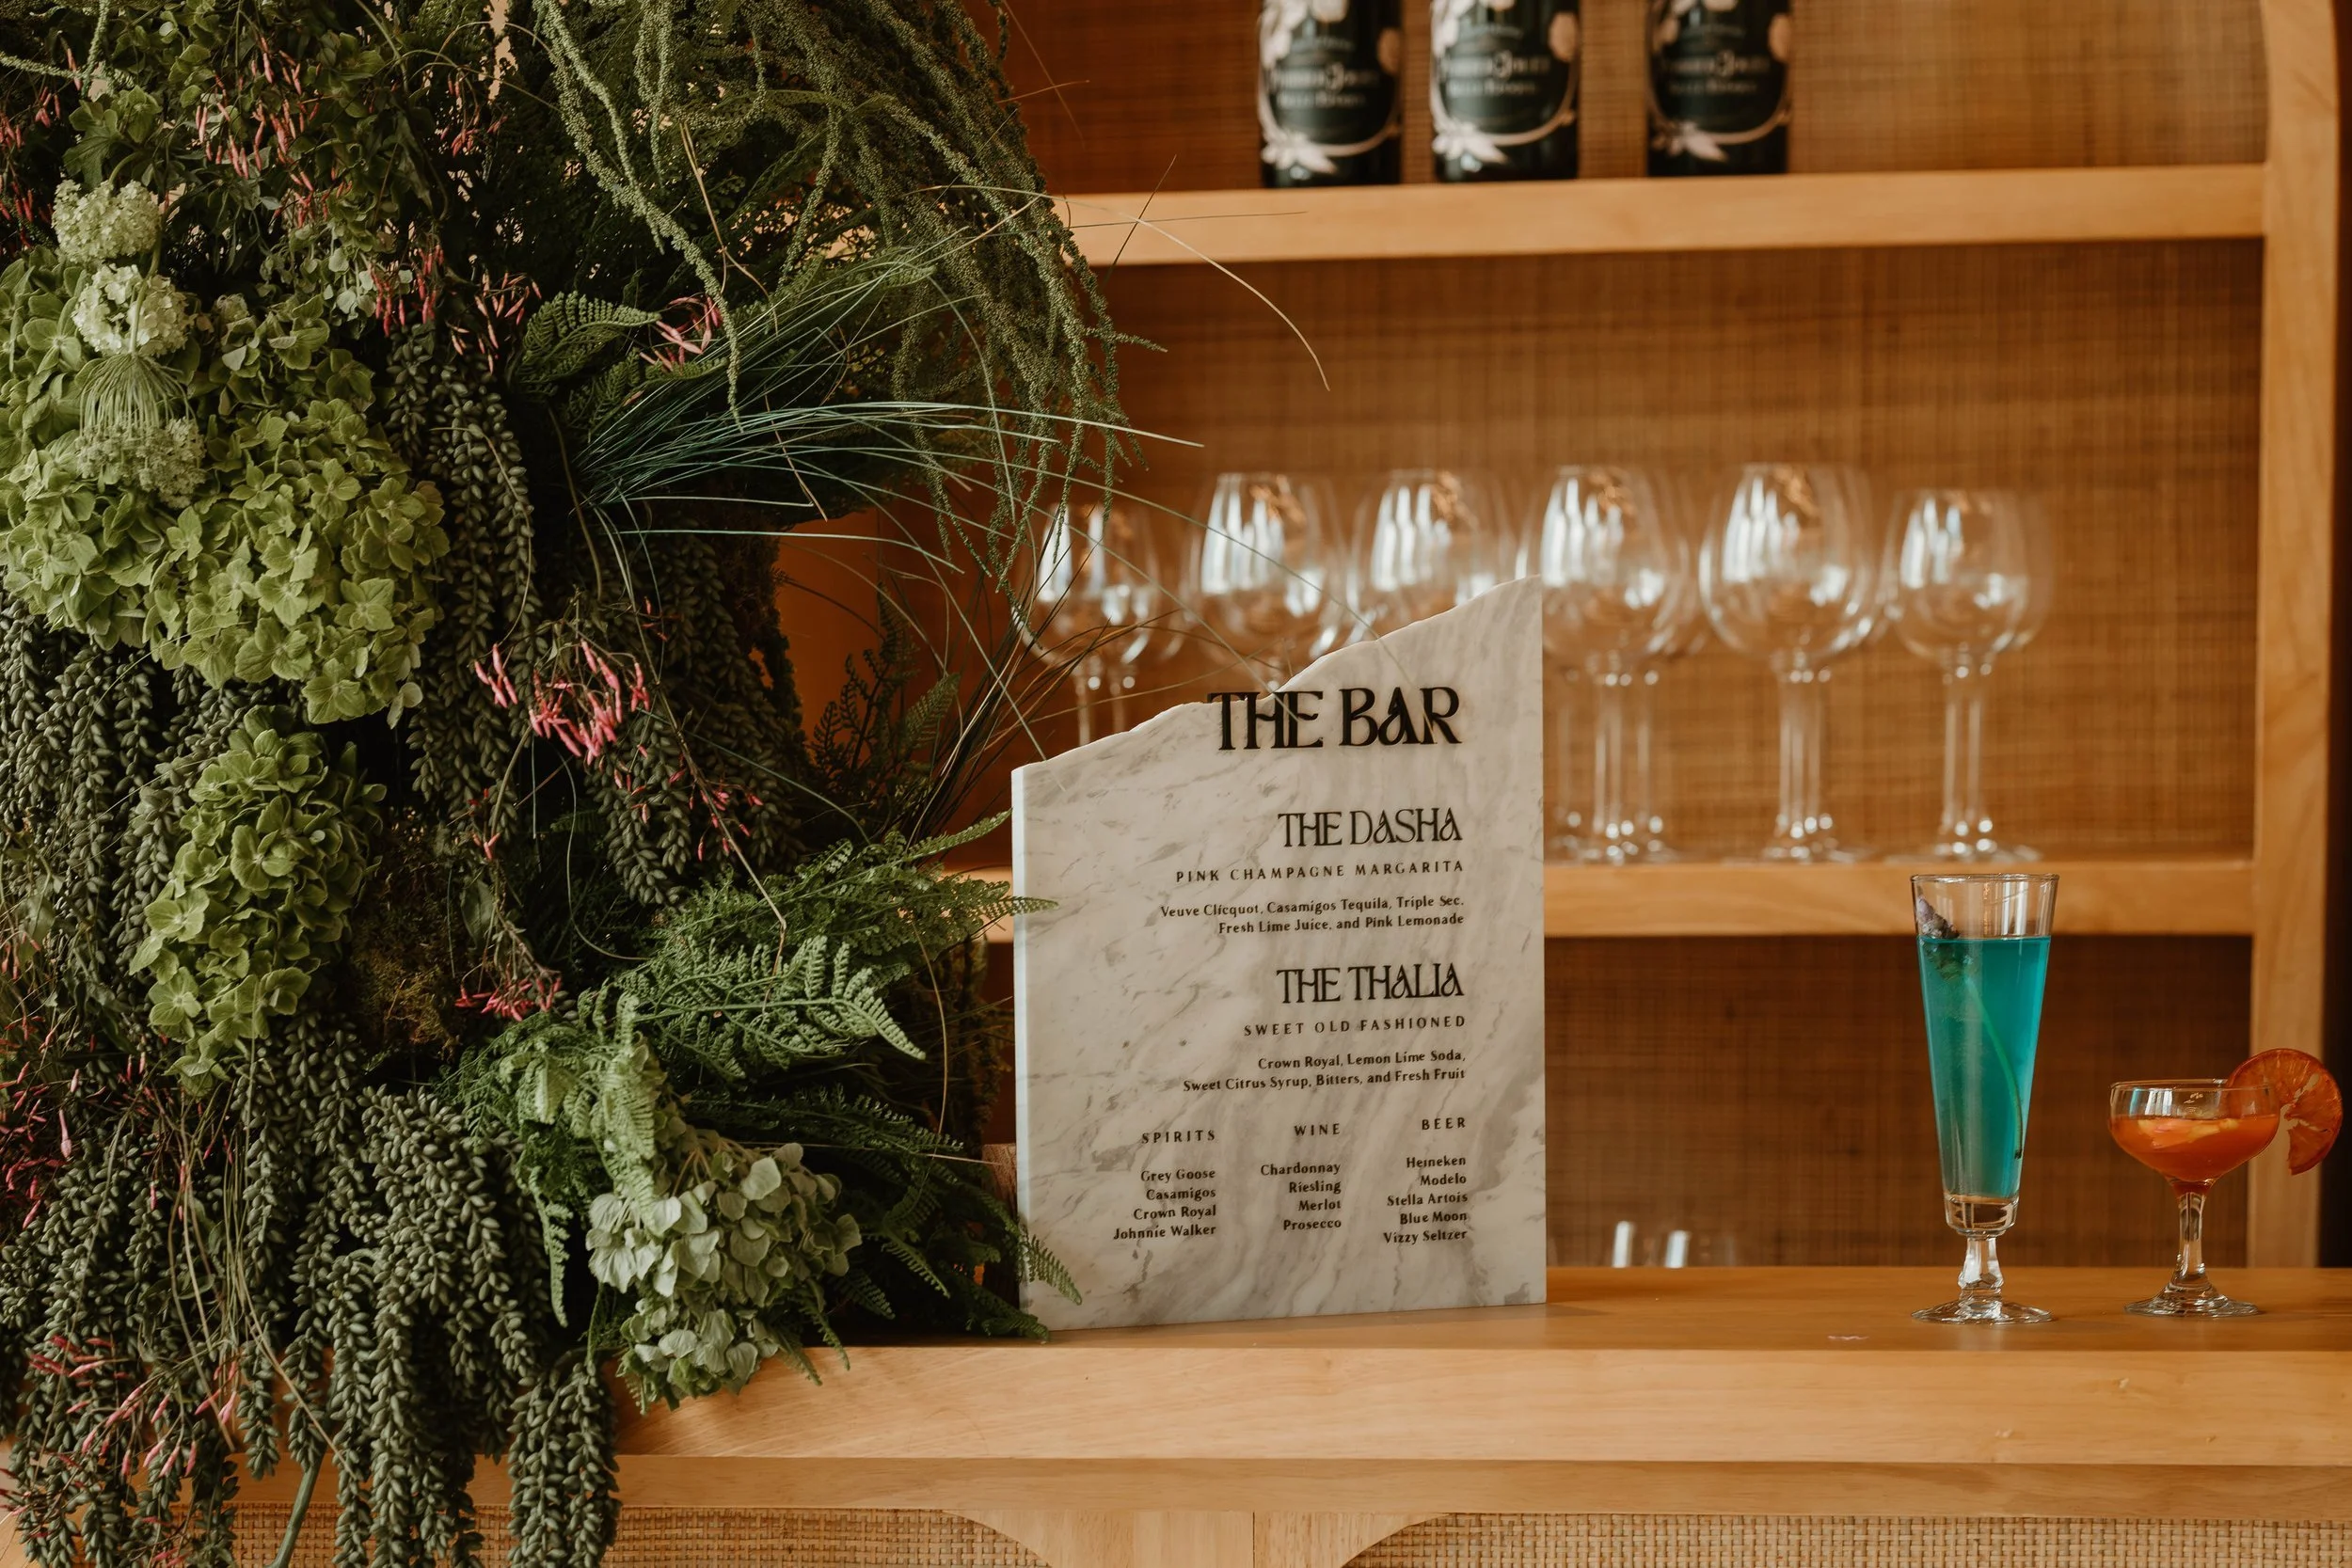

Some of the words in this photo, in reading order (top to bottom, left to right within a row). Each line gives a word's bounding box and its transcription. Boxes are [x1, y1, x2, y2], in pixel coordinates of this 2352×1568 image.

[1208, 690, 1324, 751] THE
[1339, 687, 1462, 746] BAR
[1278, 811, 1342, 847] THE
[1350, 808, 1462, 845] DASHA
[1176, 869, 1219, 882] PINK
[1230, 865, 1344, 880] CHAMPAGNE
[1355, 860, 1463, 876] MARGARITA
[1160, 905, 1200, 917] Veuve
[1266, 900, 1336, 915] Casamigos
[1340, 897, 1392, 912] Tequila,
[1396, 895, 1435, 910] Triple
[1218, 922, 1254, 934] Fresh
[1259, 920, 1290, 932] Lime
[1336, 916, 1360, 929] and
[1365, 914, 1393, 928] Pink
[1398, 912, 1464, 927] Lemonade
[1276, 967, 1341, 1004] THE
[1347, 962, 1465, 1001] THALIA
[1244, 1022, 1304, 1037] SWEET
[1314, 1020, 1350, 1034] OLD
[1360, 1015, 1466, 1031] FASHIONED
[1258, 1057, 1300, 1069] Crown
[1346, 1053, 1391, 1065] Lemon
[1395, 1051, 1425, 1064] Lime
[1430, 1049, 1466, 1062] Soda,
[1183, 1080, 1221, 1091] Sweet
[1225, 1078, 1266, 1089] Citrus
[1316, 1074, 1363, 1086] Bitters,
[1367, 1071, 1391, 1084] and
[1395, 1069, 1430, 1082] Fresh
[1434, 1068, 1465, 1080] Fruit
[1294, 1123, 1340, 1136] WINE
[1422, 1117, 1466, 1130] BEER
[1141, 1130, 1215, 1144] SPIRITS
[1261, 1162, 1341, 1176] Chardonnay
[1406, 1155, 1466, 1168] Heineken
[1140, 1170, 1171, 1183] Grey
[1176, 1168, 1216, 1180] Goose
[1420, 1172, 1467, 1186] Modelo
[1146, 1187, 1216, 1202] Casamigos
[1289, 1180, 1342, 1195] Riesling
[1298, 1198, 1341, 1212] Merlot
[1387, 1194, 1423, 1207] Stella
[1428, 1192, 1468, 1205] Artois
[1133, 1208, 1176, 1220] Crown
[1181, 1204, 1216, 1220] Royal
[1399, 1212, 1429, 1225] Blue
[1432, 1211, 1468, 1223] Moon
[1113, 1224, 1166, 1240] Johnnie
[1170, 1224, 1216, 1237] Walker
[1283, 1219, 1342, 1231] Prosecco
[1383, 1231, 1419, 1245] Vizzy
[1422, 1229, 1468, 1242] Seltzer
